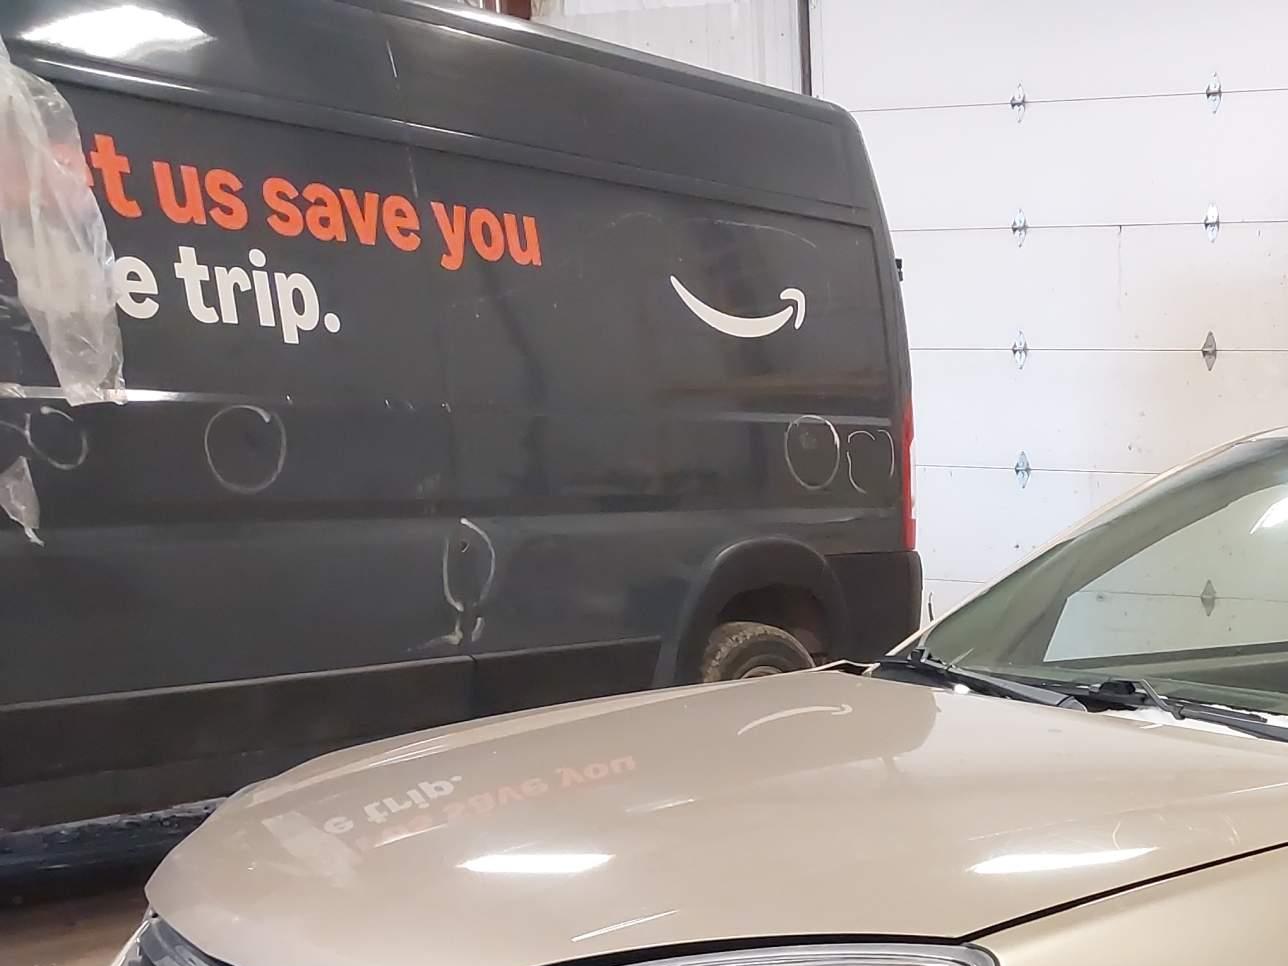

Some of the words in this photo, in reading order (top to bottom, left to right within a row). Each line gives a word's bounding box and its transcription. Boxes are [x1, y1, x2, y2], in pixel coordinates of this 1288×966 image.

[152, 161, 249, 231] us
[262, 177, 422, 252] save
[430, 200, 543, 271] you
[173, 245, 341, 344] trip.
